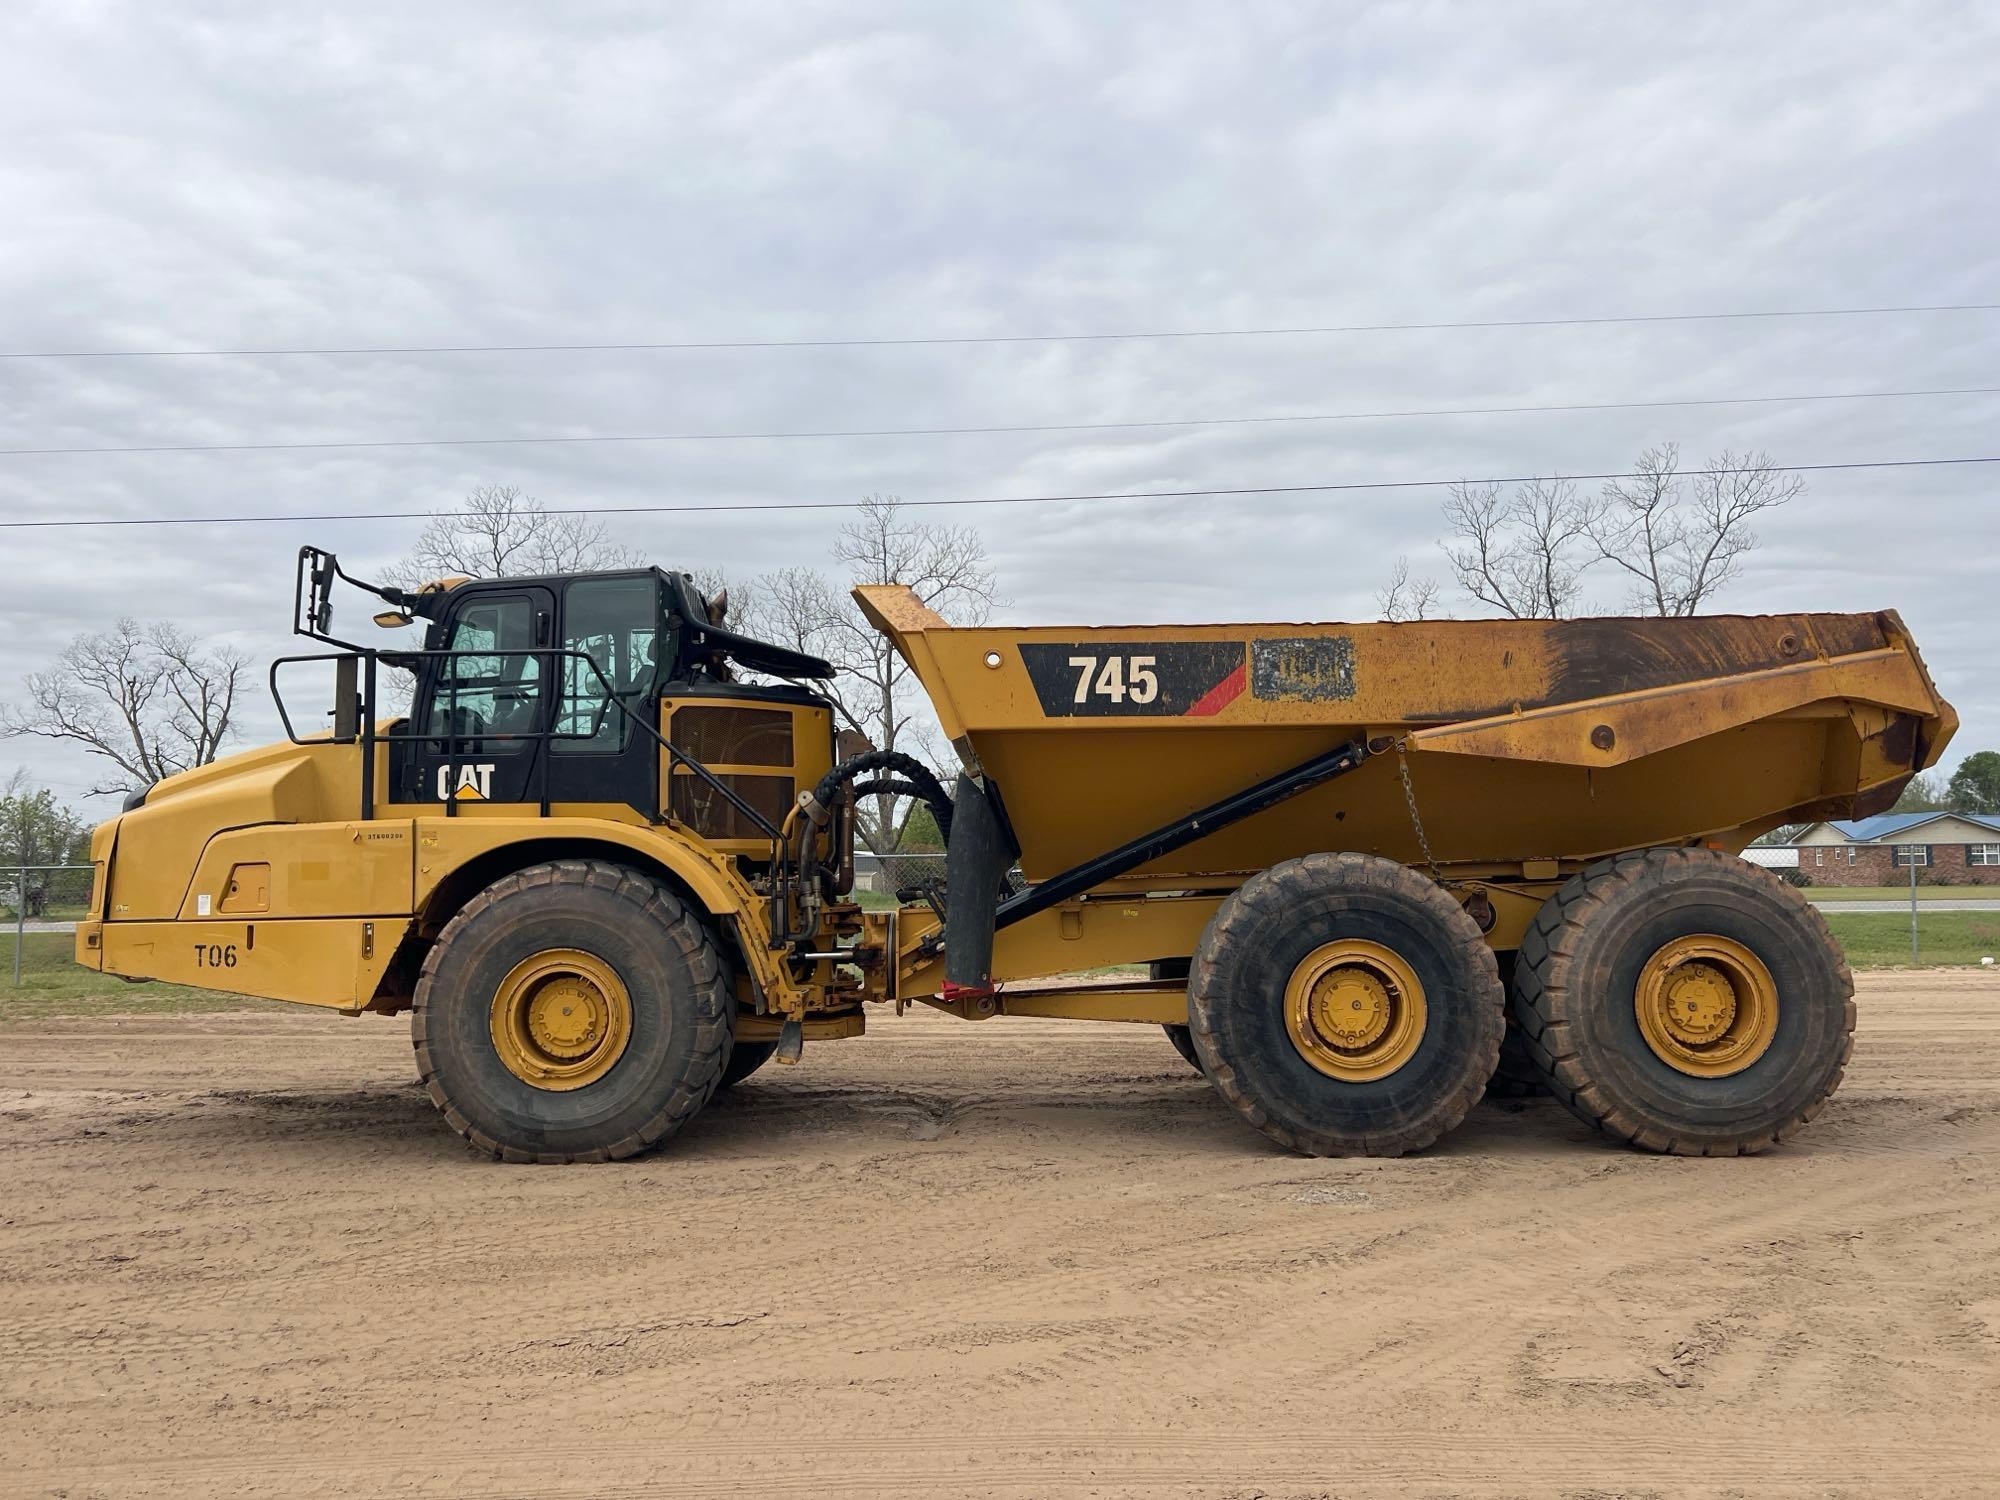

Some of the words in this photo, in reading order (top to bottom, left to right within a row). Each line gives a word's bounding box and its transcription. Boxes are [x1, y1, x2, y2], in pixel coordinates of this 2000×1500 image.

[1068, 656, 1158, 704] 745
[437, 764, 495, 800] CAT
[194, 944, 237, 968] T06
